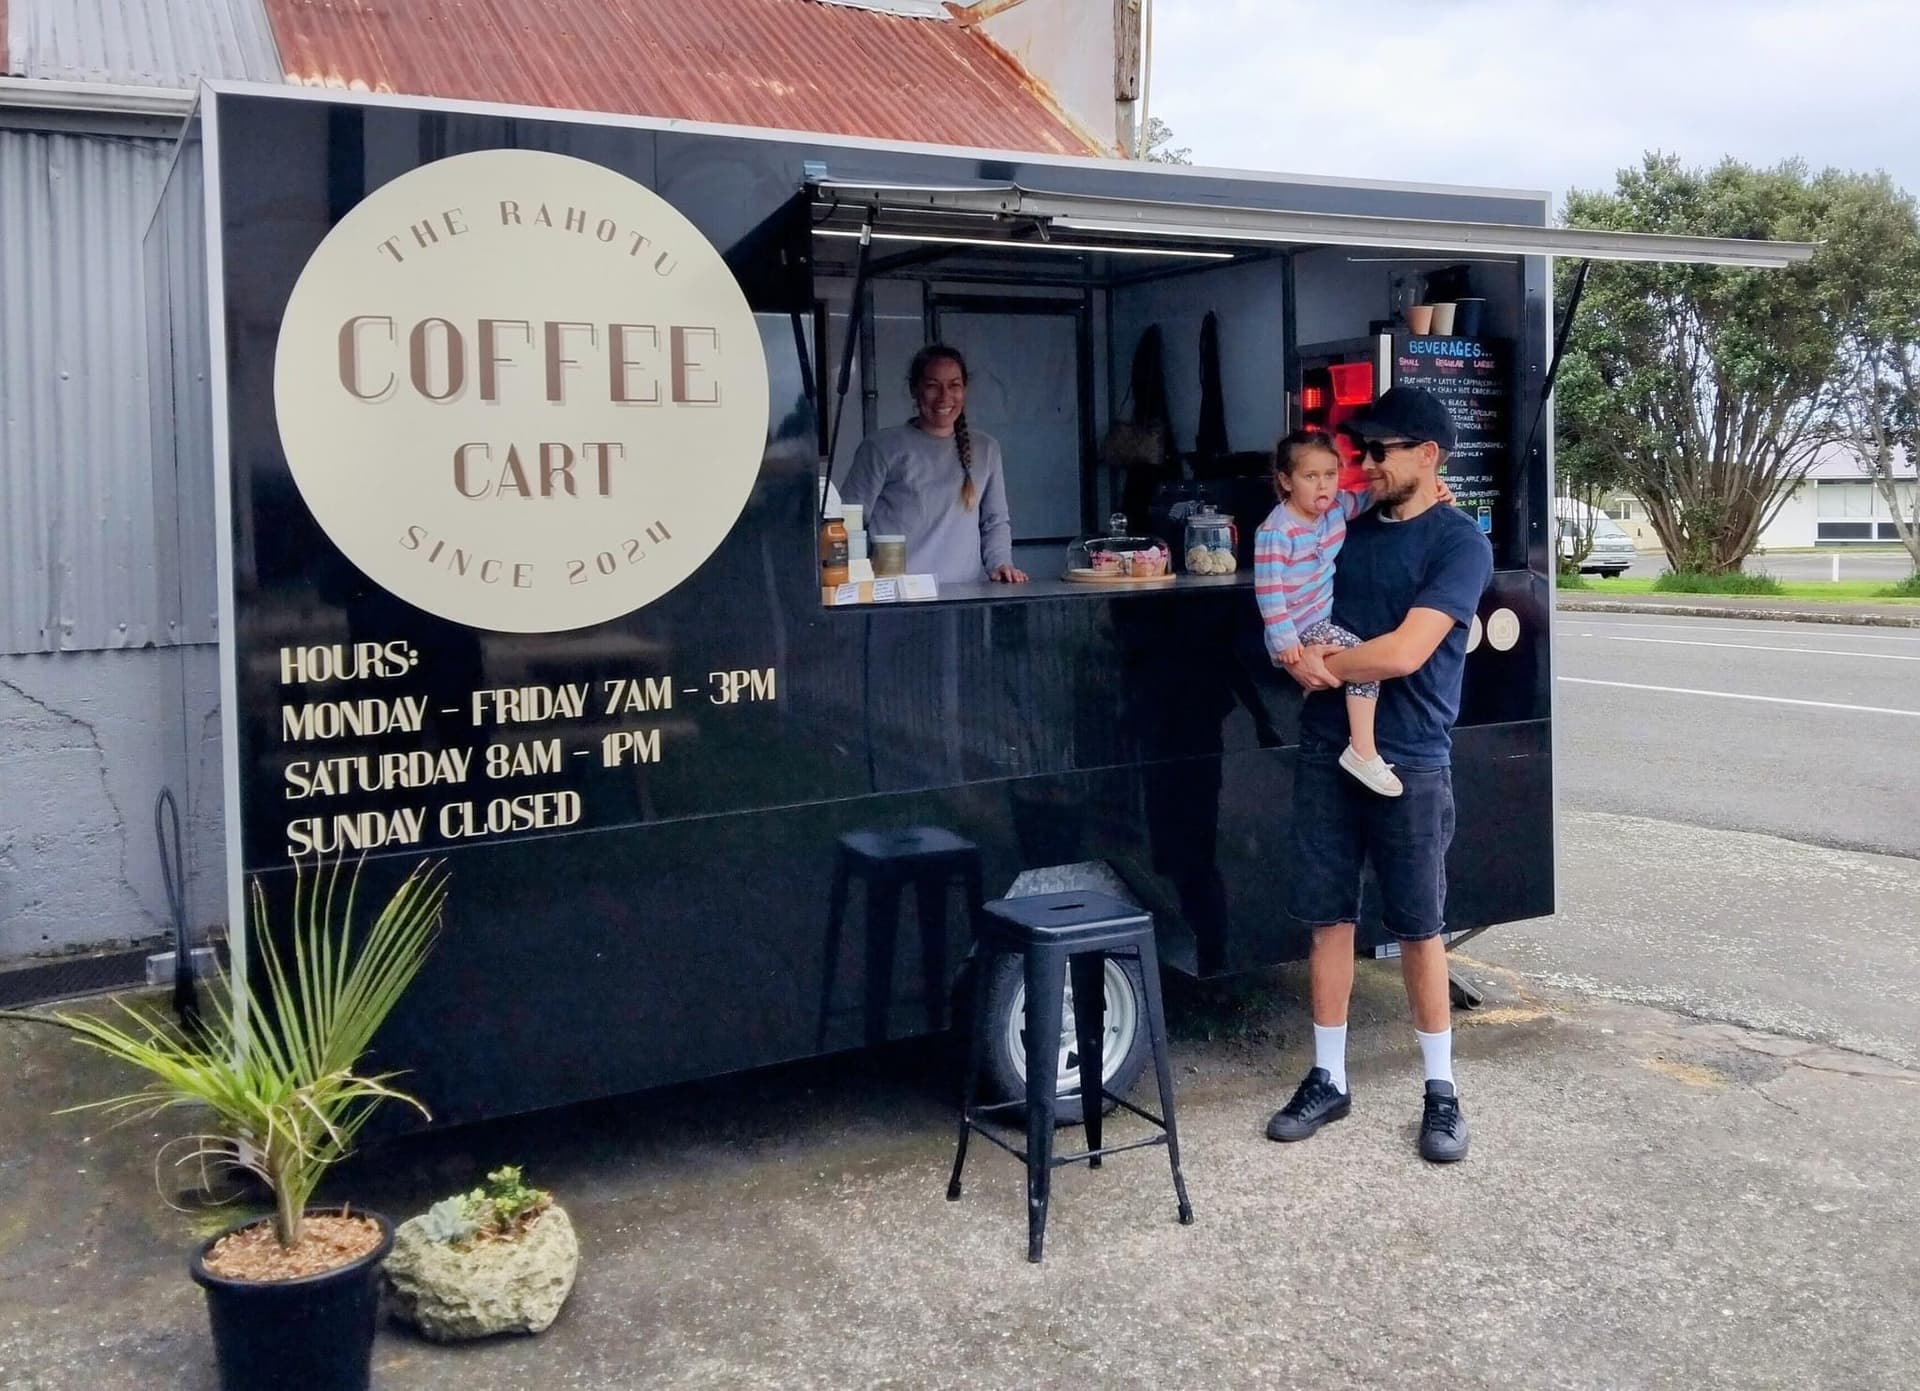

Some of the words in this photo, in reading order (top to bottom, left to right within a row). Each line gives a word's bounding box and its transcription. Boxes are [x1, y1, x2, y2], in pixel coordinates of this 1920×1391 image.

[377, 207, 469, 263] THE
[500, 200, 678, 277] RAHOTU
[338, 315, 721, 407] COFFEE
[453, 442, 627, 499] CART
[399, 524, 534, 588] SINCE
[568, 520, 672, 585] 2024
[280, 640, 419, 685] HOURS:
[282, 695, 428, 743] MONDAY
[472, 682, 590, 726] FRIDAY
[603, 676, 672, 714] 7AM
[709, 668, 776, 705] 3PM
[284, 747, 473, 800] SATURDAY
[486, 739, 562, 780] 8AM
[601, 728, 661, 768] 1PM
[286, 806, 426, 857] SUNDAY
[440, 791, 581, 838] CLOSED
